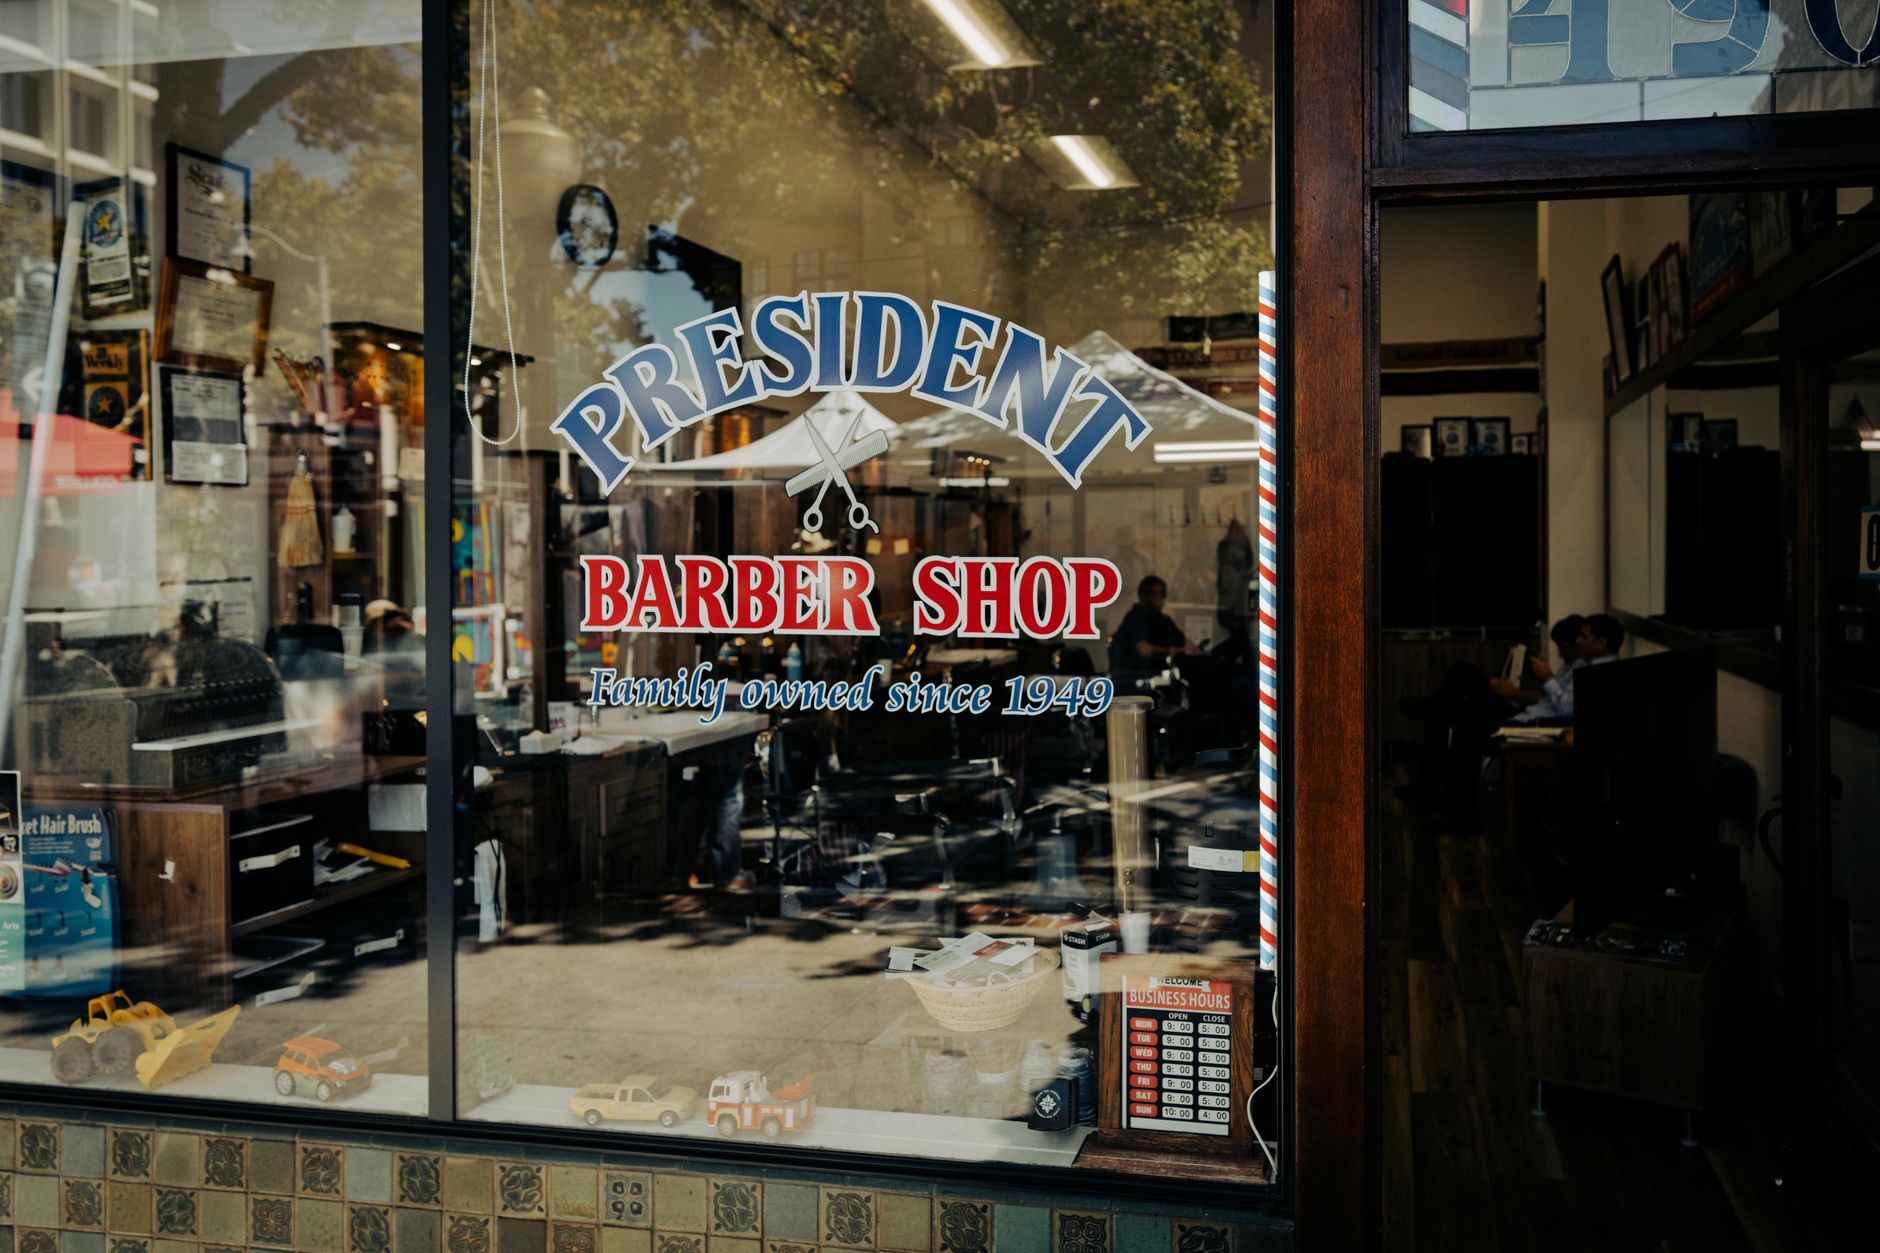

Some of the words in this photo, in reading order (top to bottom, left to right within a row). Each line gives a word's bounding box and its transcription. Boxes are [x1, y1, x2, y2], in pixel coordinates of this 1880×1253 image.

[549, 289, 1154, 497] PRESIDENT
[579, 554, 881, 636] BARBER
[912, 554, 1123, 640] SHOP
[586, 660, 730, 725] Family
[739, 664, 884, 714] owned
[884, 670, 993, 715] since
[1001, 674, 1115, 719] 1949
[40, 813, 67, 835] Hair
[68, 813, 102, 835] Brush
[2, 921, 20, 930] Arts
[1068, 935, 1086, 945] STASH
[1129, 988, 1187, 1006] BUSINESS
[1189, 993, 1231, 1009] HOURS
[1168, 1012, 1188, 1020] OPEN
[1203, 1014, 1226, 1023] CLOSE
[1135, 1019, 1153, 1029] MON
[1136, 1034, 1152, 1043] TUE
[1135, 1048, 1153, 1057] WED
[1135, 1062, 1152, 1071] THU
[1137, 1077, 1150, 1085] FRI
[1135, 1091, 1152, 1100] SAT
[1135, 1105, 1152, 1115] SUN
